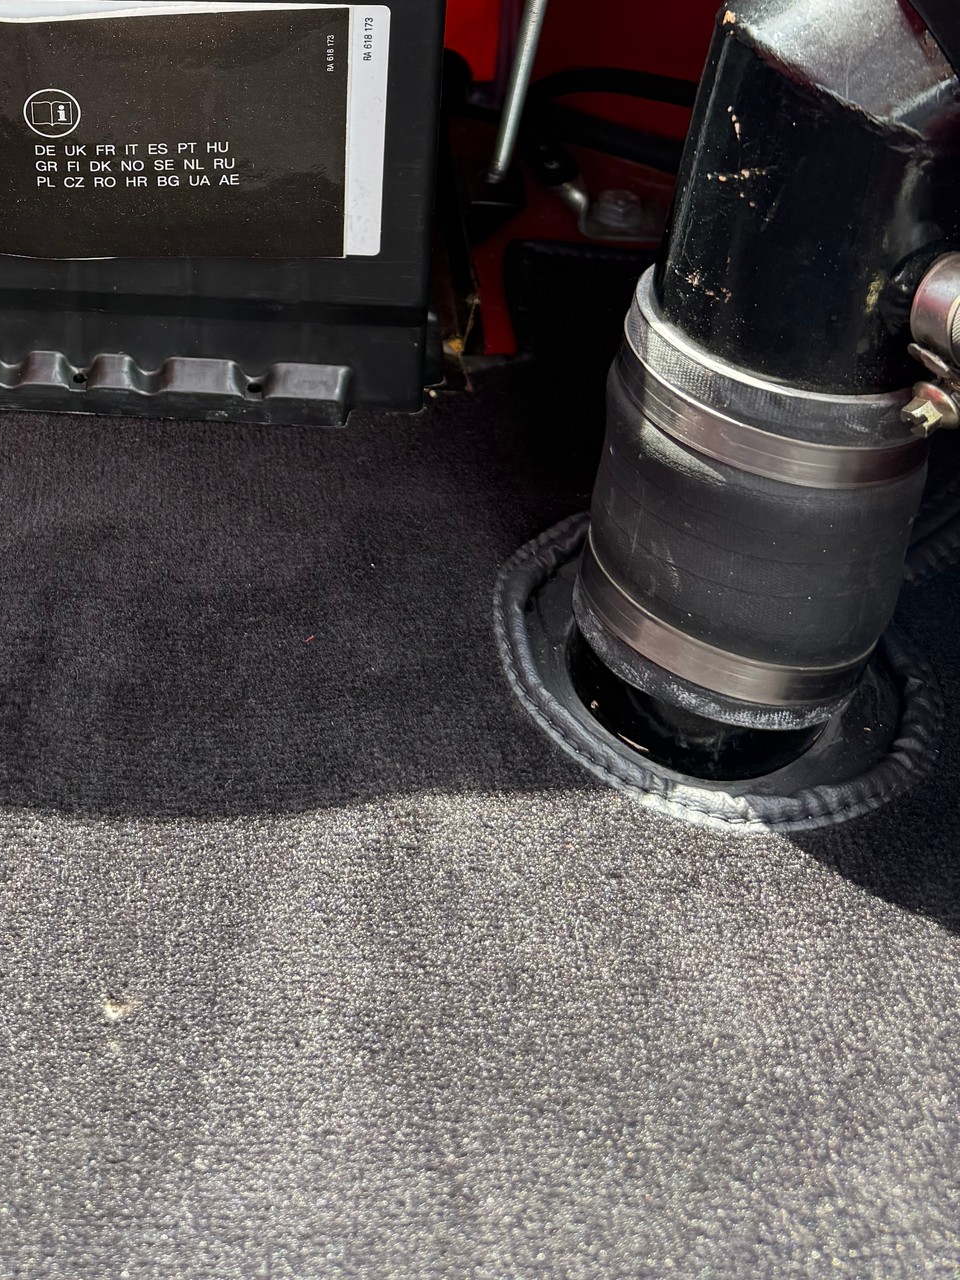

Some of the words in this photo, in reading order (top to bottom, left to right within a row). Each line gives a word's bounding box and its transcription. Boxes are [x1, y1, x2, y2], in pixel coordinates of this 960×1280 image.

[364, 17, 374, 32] 173
[326, 34, 335, 47] 173
[363, 34, 373, 50] 618
[326, 48, 335, 62] 618
[363, 51, 372, 62] RA
[326, 63, 335, 72] RA
[34, 144, 56, 156] DE
[64, 144, 87, 157] UK
[95, 144, 116, 156] FR
[125, 143, 139, 155] IT
[148, 142, 168, 155] ES
[177, 142, 198, 154] PT
[206, 141, 229, 154] HU
[35, 160, 58, 172] GR
[67, 160, 80, 172] FI
[89, 160, 112, 172] DK
[120, 160, 145, 172] NO
[153, 159, 175, 171] SE
[183, 158, 205, 170] NL
[213, 157, 235, 170] RU
[36, 176, 56, 188] PL
[63, 176, 85, 188] CZ
[93, 176, 117, 188] RO
[125, 176, 148, 188] HR
[157, 175, 180, 187] BG
[189, 174, 211, 187] UA
[218, 173, 240, 186] AE
